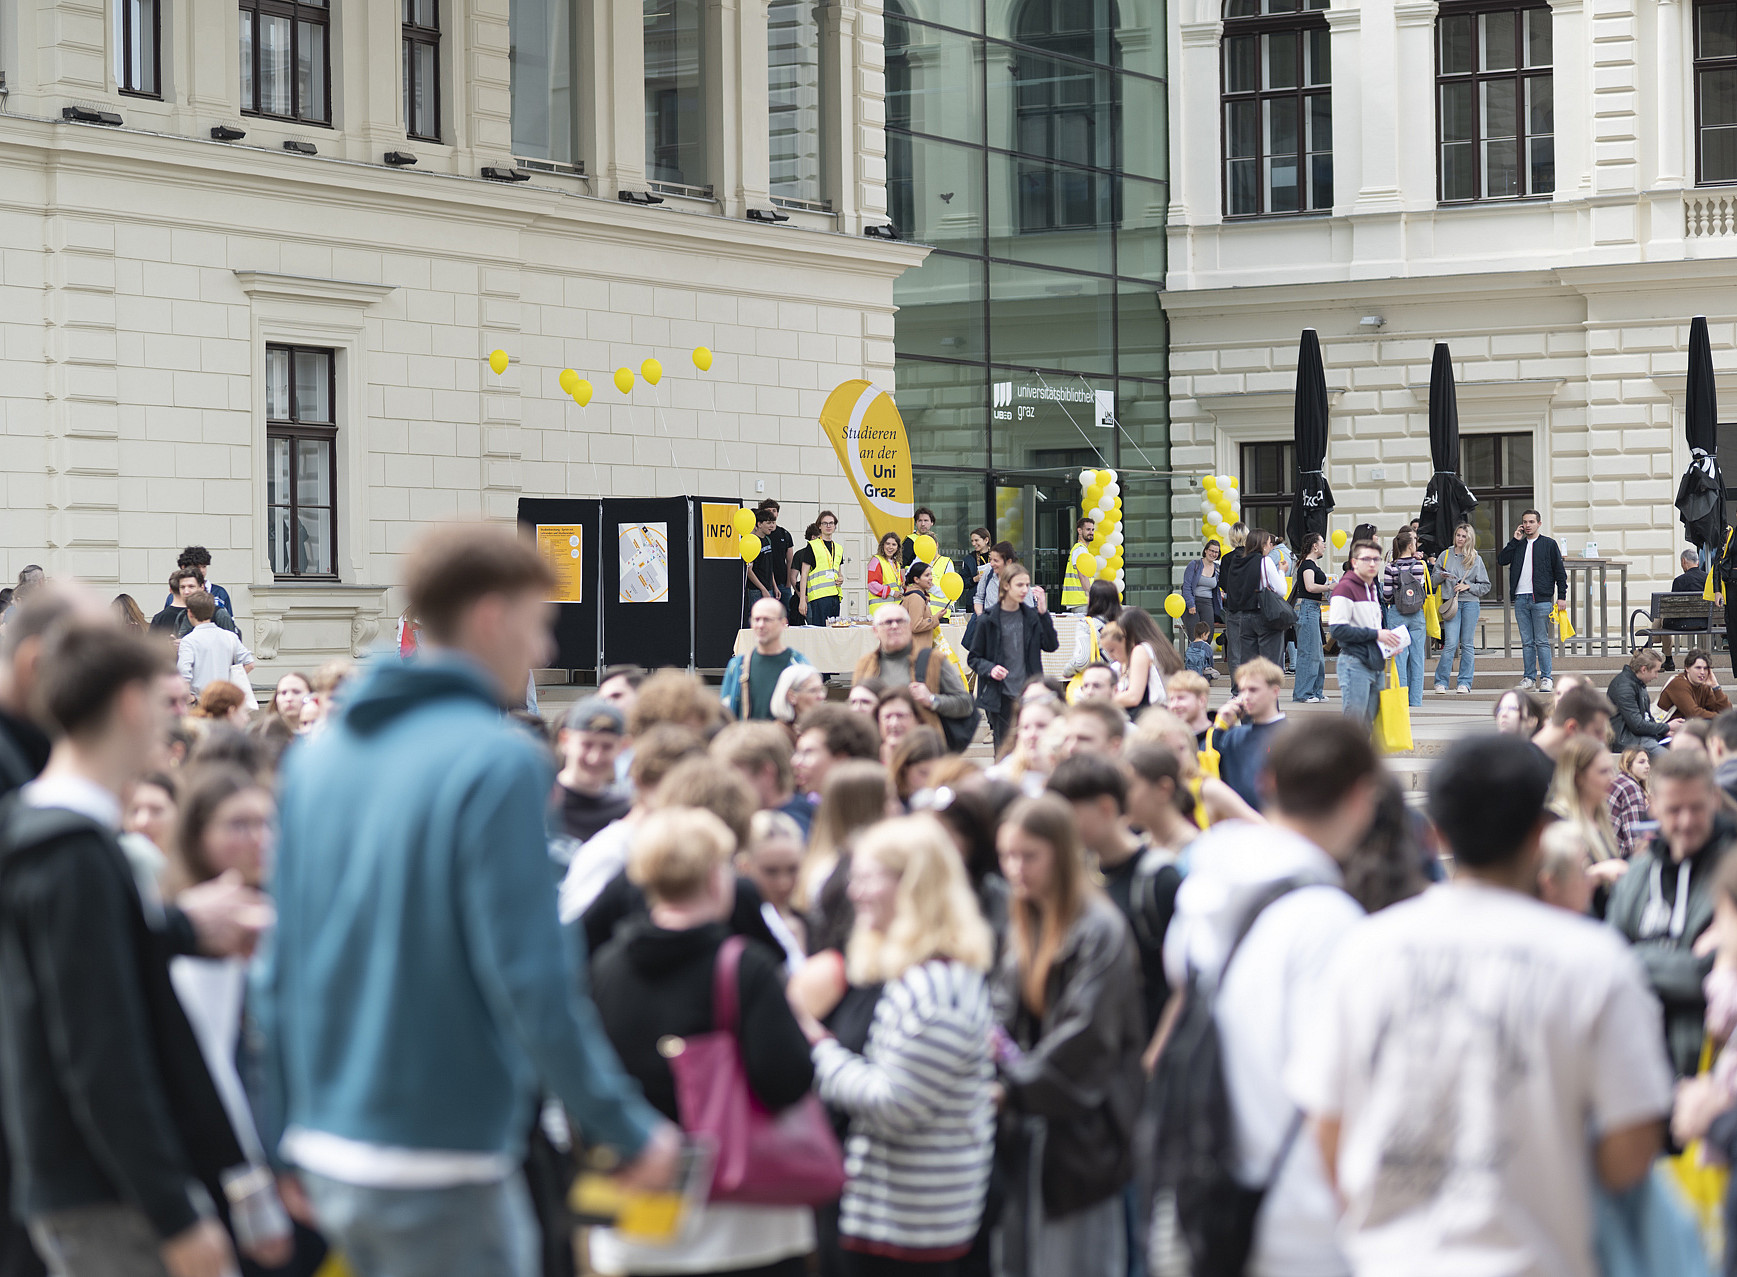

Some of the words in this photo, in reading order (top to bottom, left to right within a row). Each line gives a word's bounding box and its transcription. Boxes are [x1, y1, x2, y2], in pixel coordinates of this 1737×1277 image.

[1017, 383, 1095, 404] universitätsbibliothek
[1017, 405, 1035, 421] graz
[841, 425, 897, 440] Studieren
[859, 448, 874, 459] an
[877, 445, 898, 459] der
[873, 464, 896, 479] Uni
[863, 483, 896, 498] Graz
[706, 523, 732, 538] INFO
